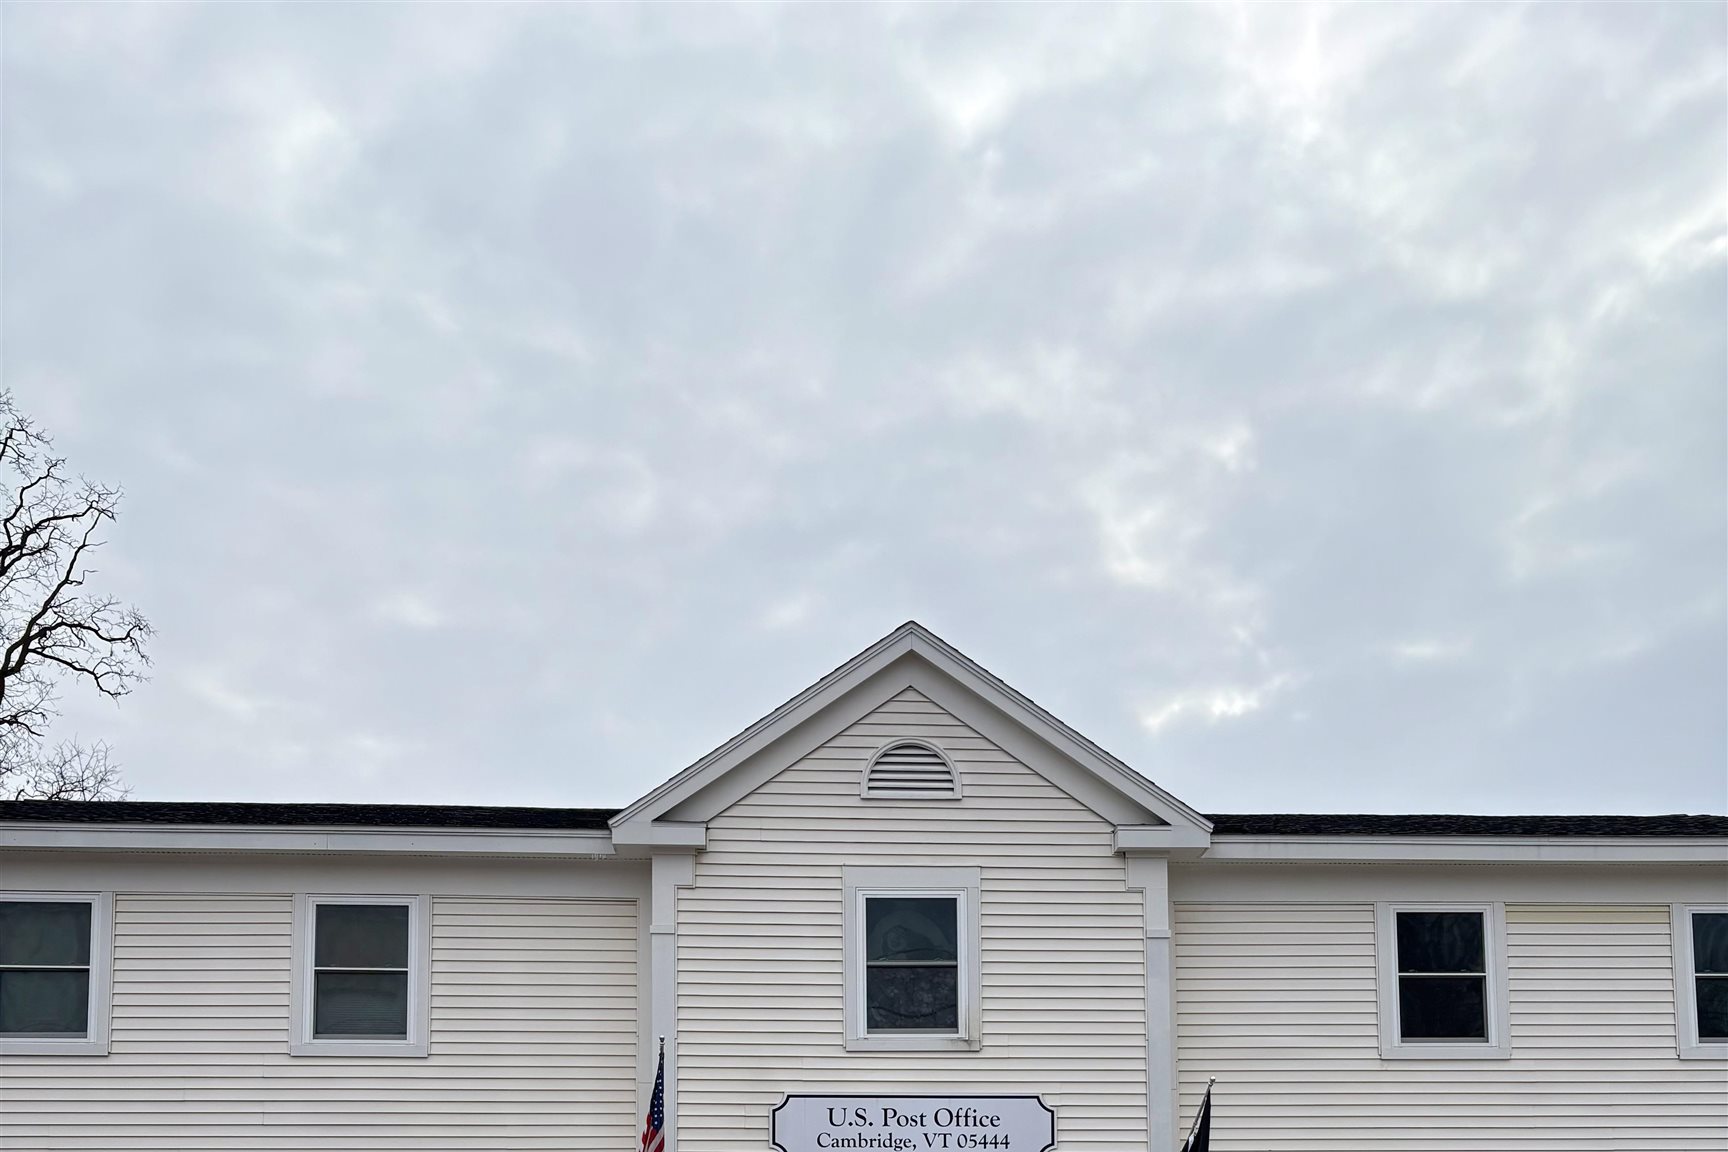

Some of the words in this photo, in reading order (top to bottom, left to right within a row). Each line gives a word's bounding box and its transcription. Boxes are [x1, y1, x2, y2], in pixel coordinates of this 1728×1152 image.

[827, 1107, 874, 1127] U.S.
[881, 1107, 927, 1127] Post
[934, 1107, 1001, 1127] Office
[816, 1132, 917, 1151] Cambridge,
[922, 1133, 952, 1149] VT
[956, 1133, 1011, 1149] 05444
